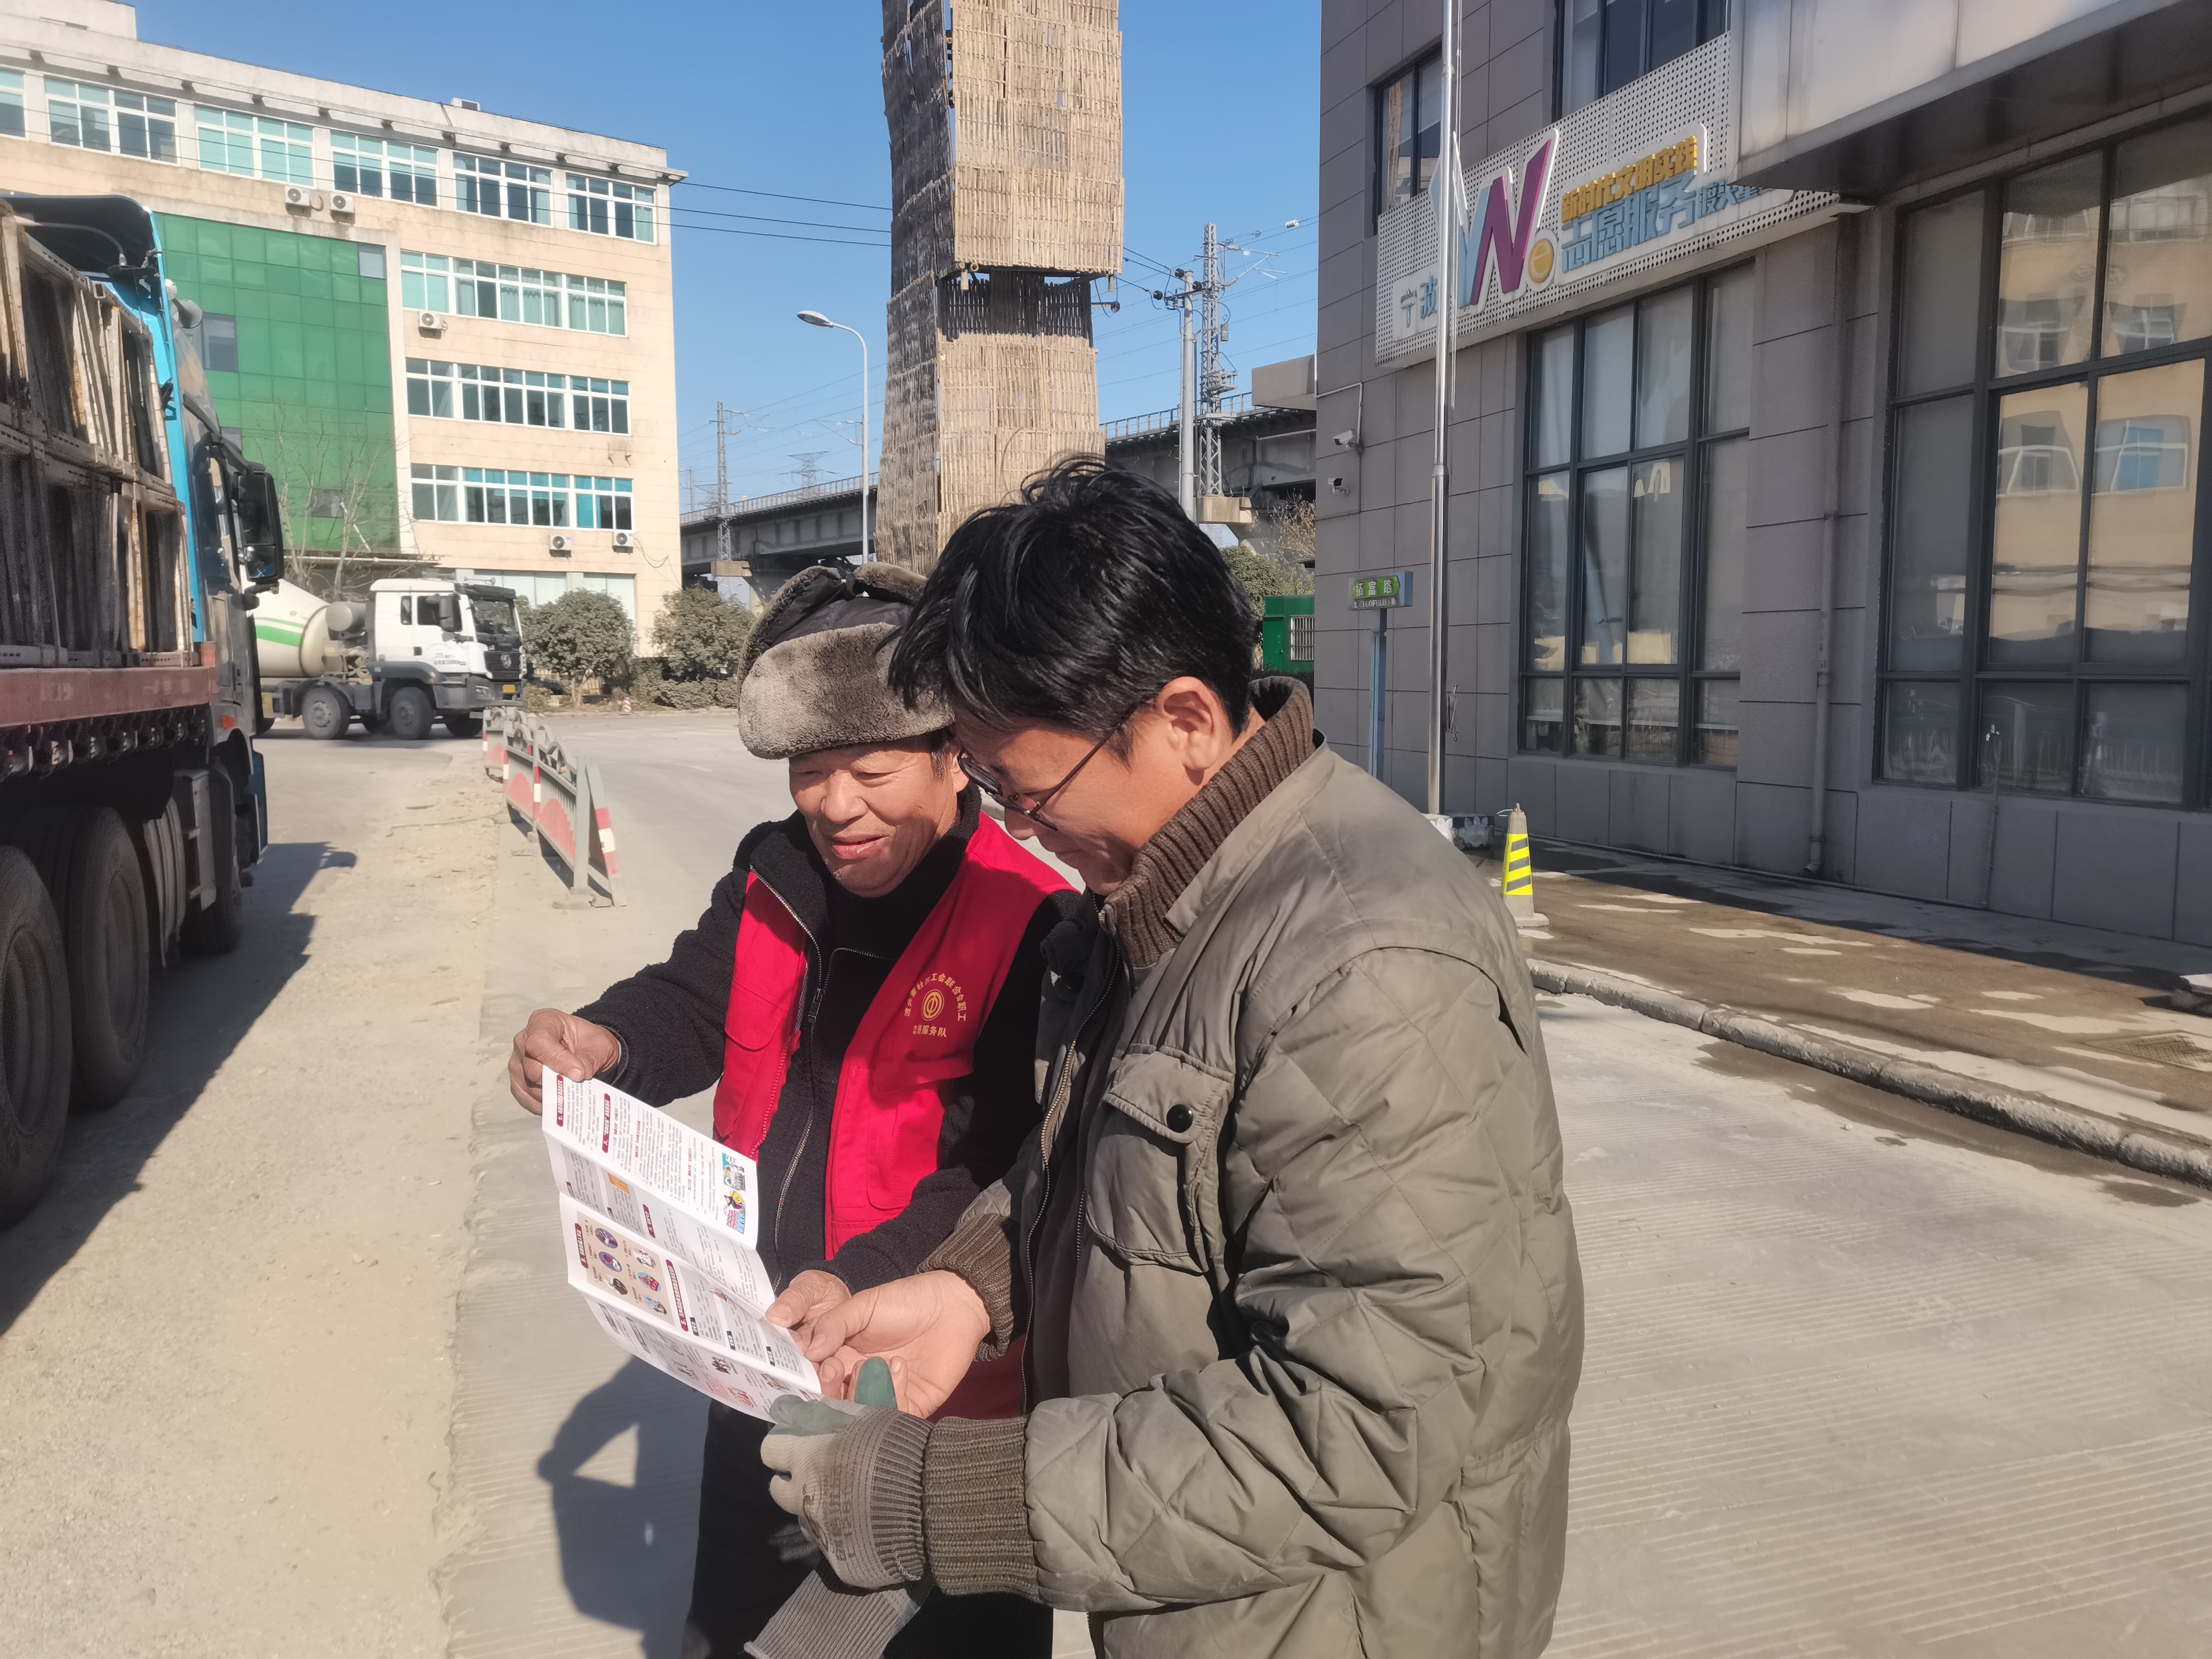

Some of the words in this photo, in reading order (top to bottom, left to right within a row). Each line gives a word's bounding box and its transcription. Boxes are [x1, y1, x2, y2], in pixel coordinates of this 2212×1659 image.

[1562, 135, 1697, 223] 新时代文明实践
[1356, 579, 1393, 597] 拓富路
